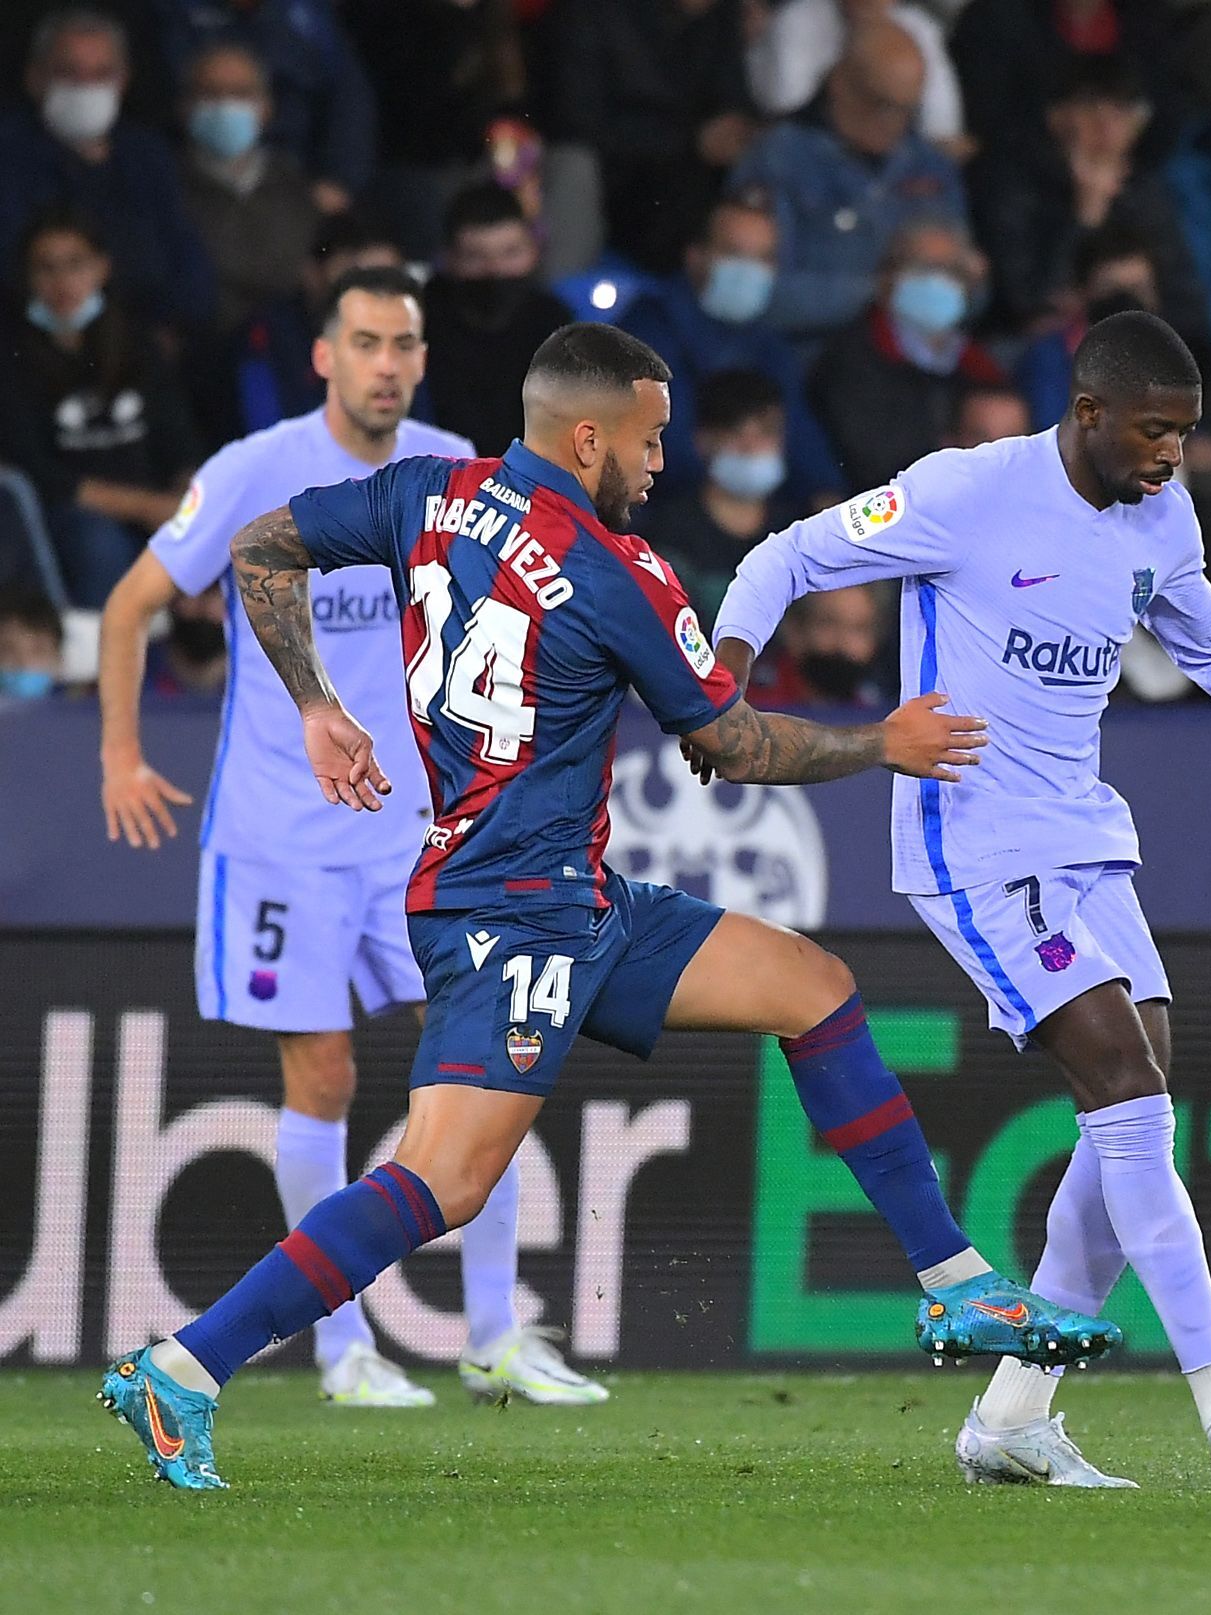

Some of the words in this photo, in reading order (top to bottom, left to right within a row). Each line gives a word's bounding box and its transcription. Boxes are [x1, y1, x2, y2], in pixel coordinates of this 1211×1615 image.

[498, 522, 574, 611] VEZO
[254, 899, 288, 962] 5
[1002, 874, 1048, 937] 7
[502, 954, 575, 1029] 14
